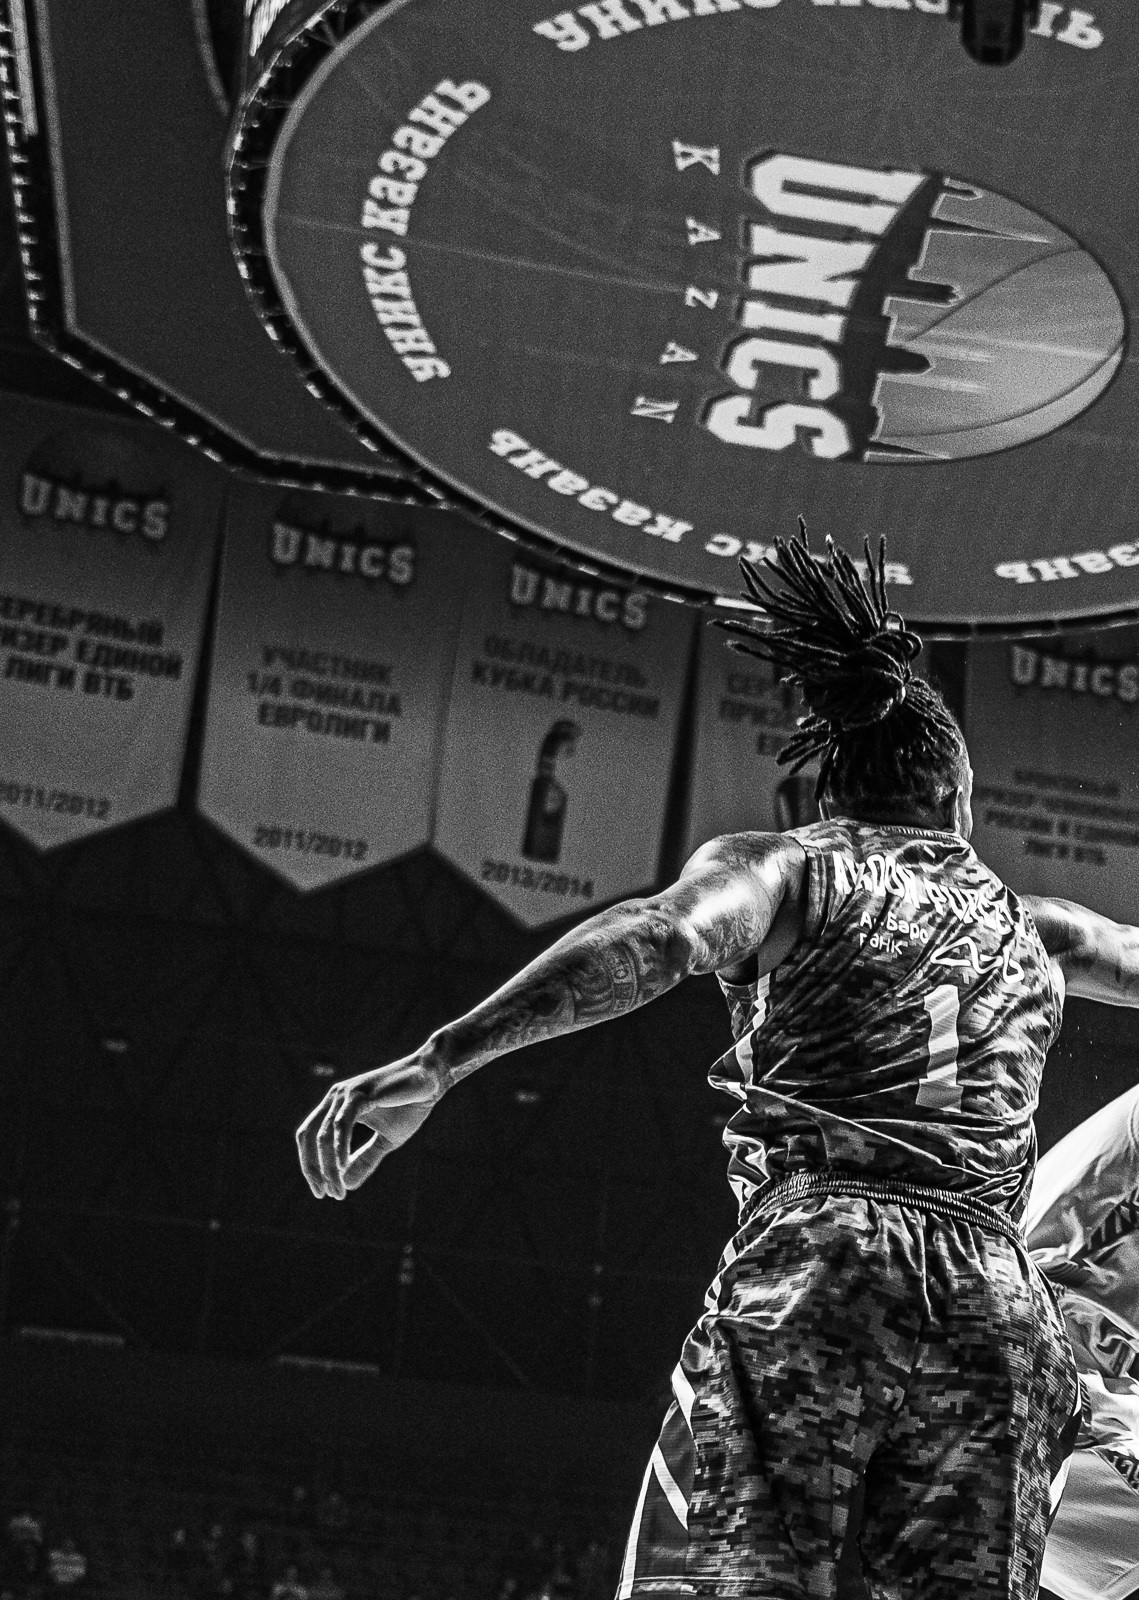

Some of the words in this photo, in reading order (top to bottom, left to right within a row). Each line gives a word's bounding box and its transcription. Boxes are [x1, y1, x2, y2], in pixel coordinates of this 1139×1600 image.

[360, 241, 452, 383] УНИКС
[705, 154, 927, 459] UNICS
[22, 473, 170, 541] UNICS
[273, 522, 416, 585] UNICS
[511, 563, 649, 630] UNICS
[915, 983, 964, 1114] 1
